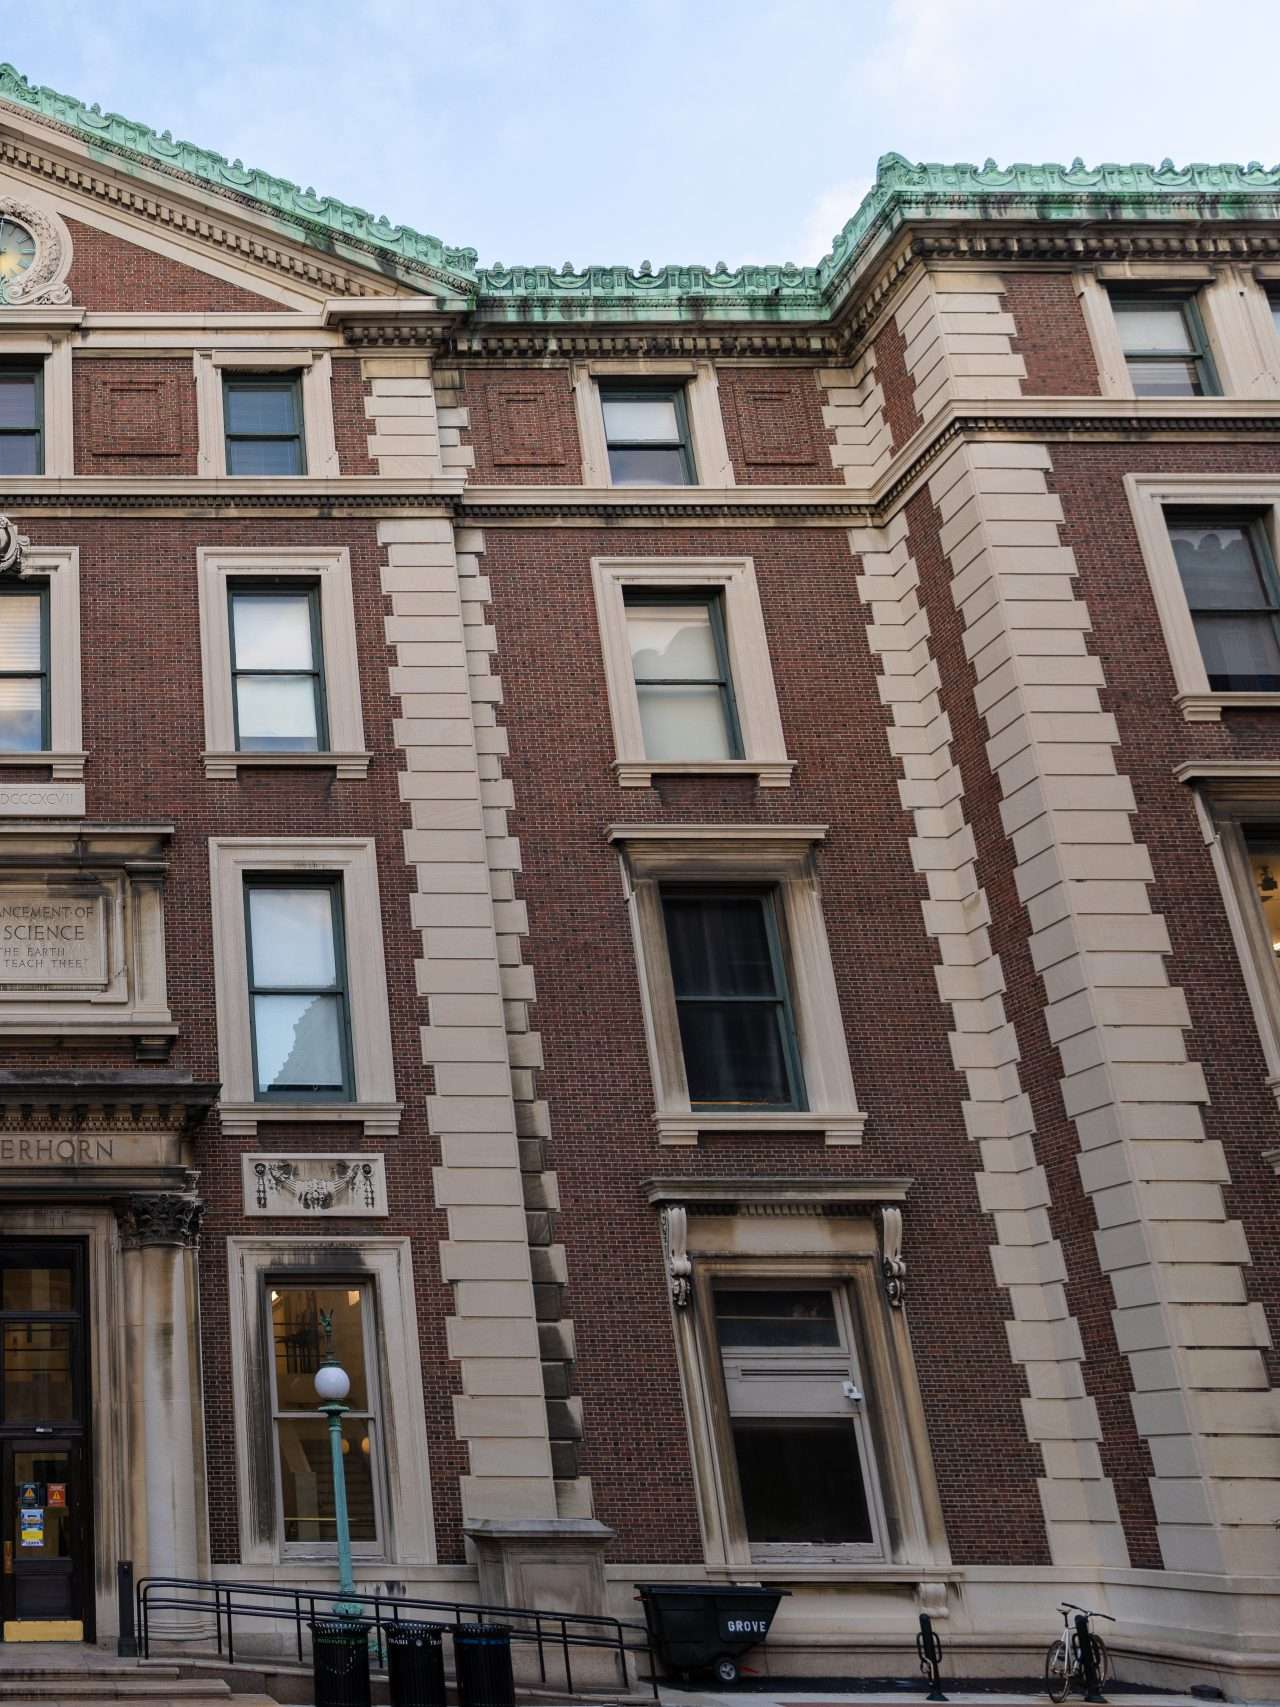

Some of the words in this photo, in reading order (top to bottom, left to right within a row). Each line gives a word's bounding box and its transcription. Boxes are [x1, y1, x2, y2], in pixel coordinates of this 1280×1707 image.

[74, 906, 94, 918] OF
[3, 925, 85, 941] SCIENCE
[27, 947, 65, 957] EARTH
[5, 959, 43, 968] TEACH
[51, 959, 82, 968] THEE
[727, 1620, 766, 1632] GROVE
